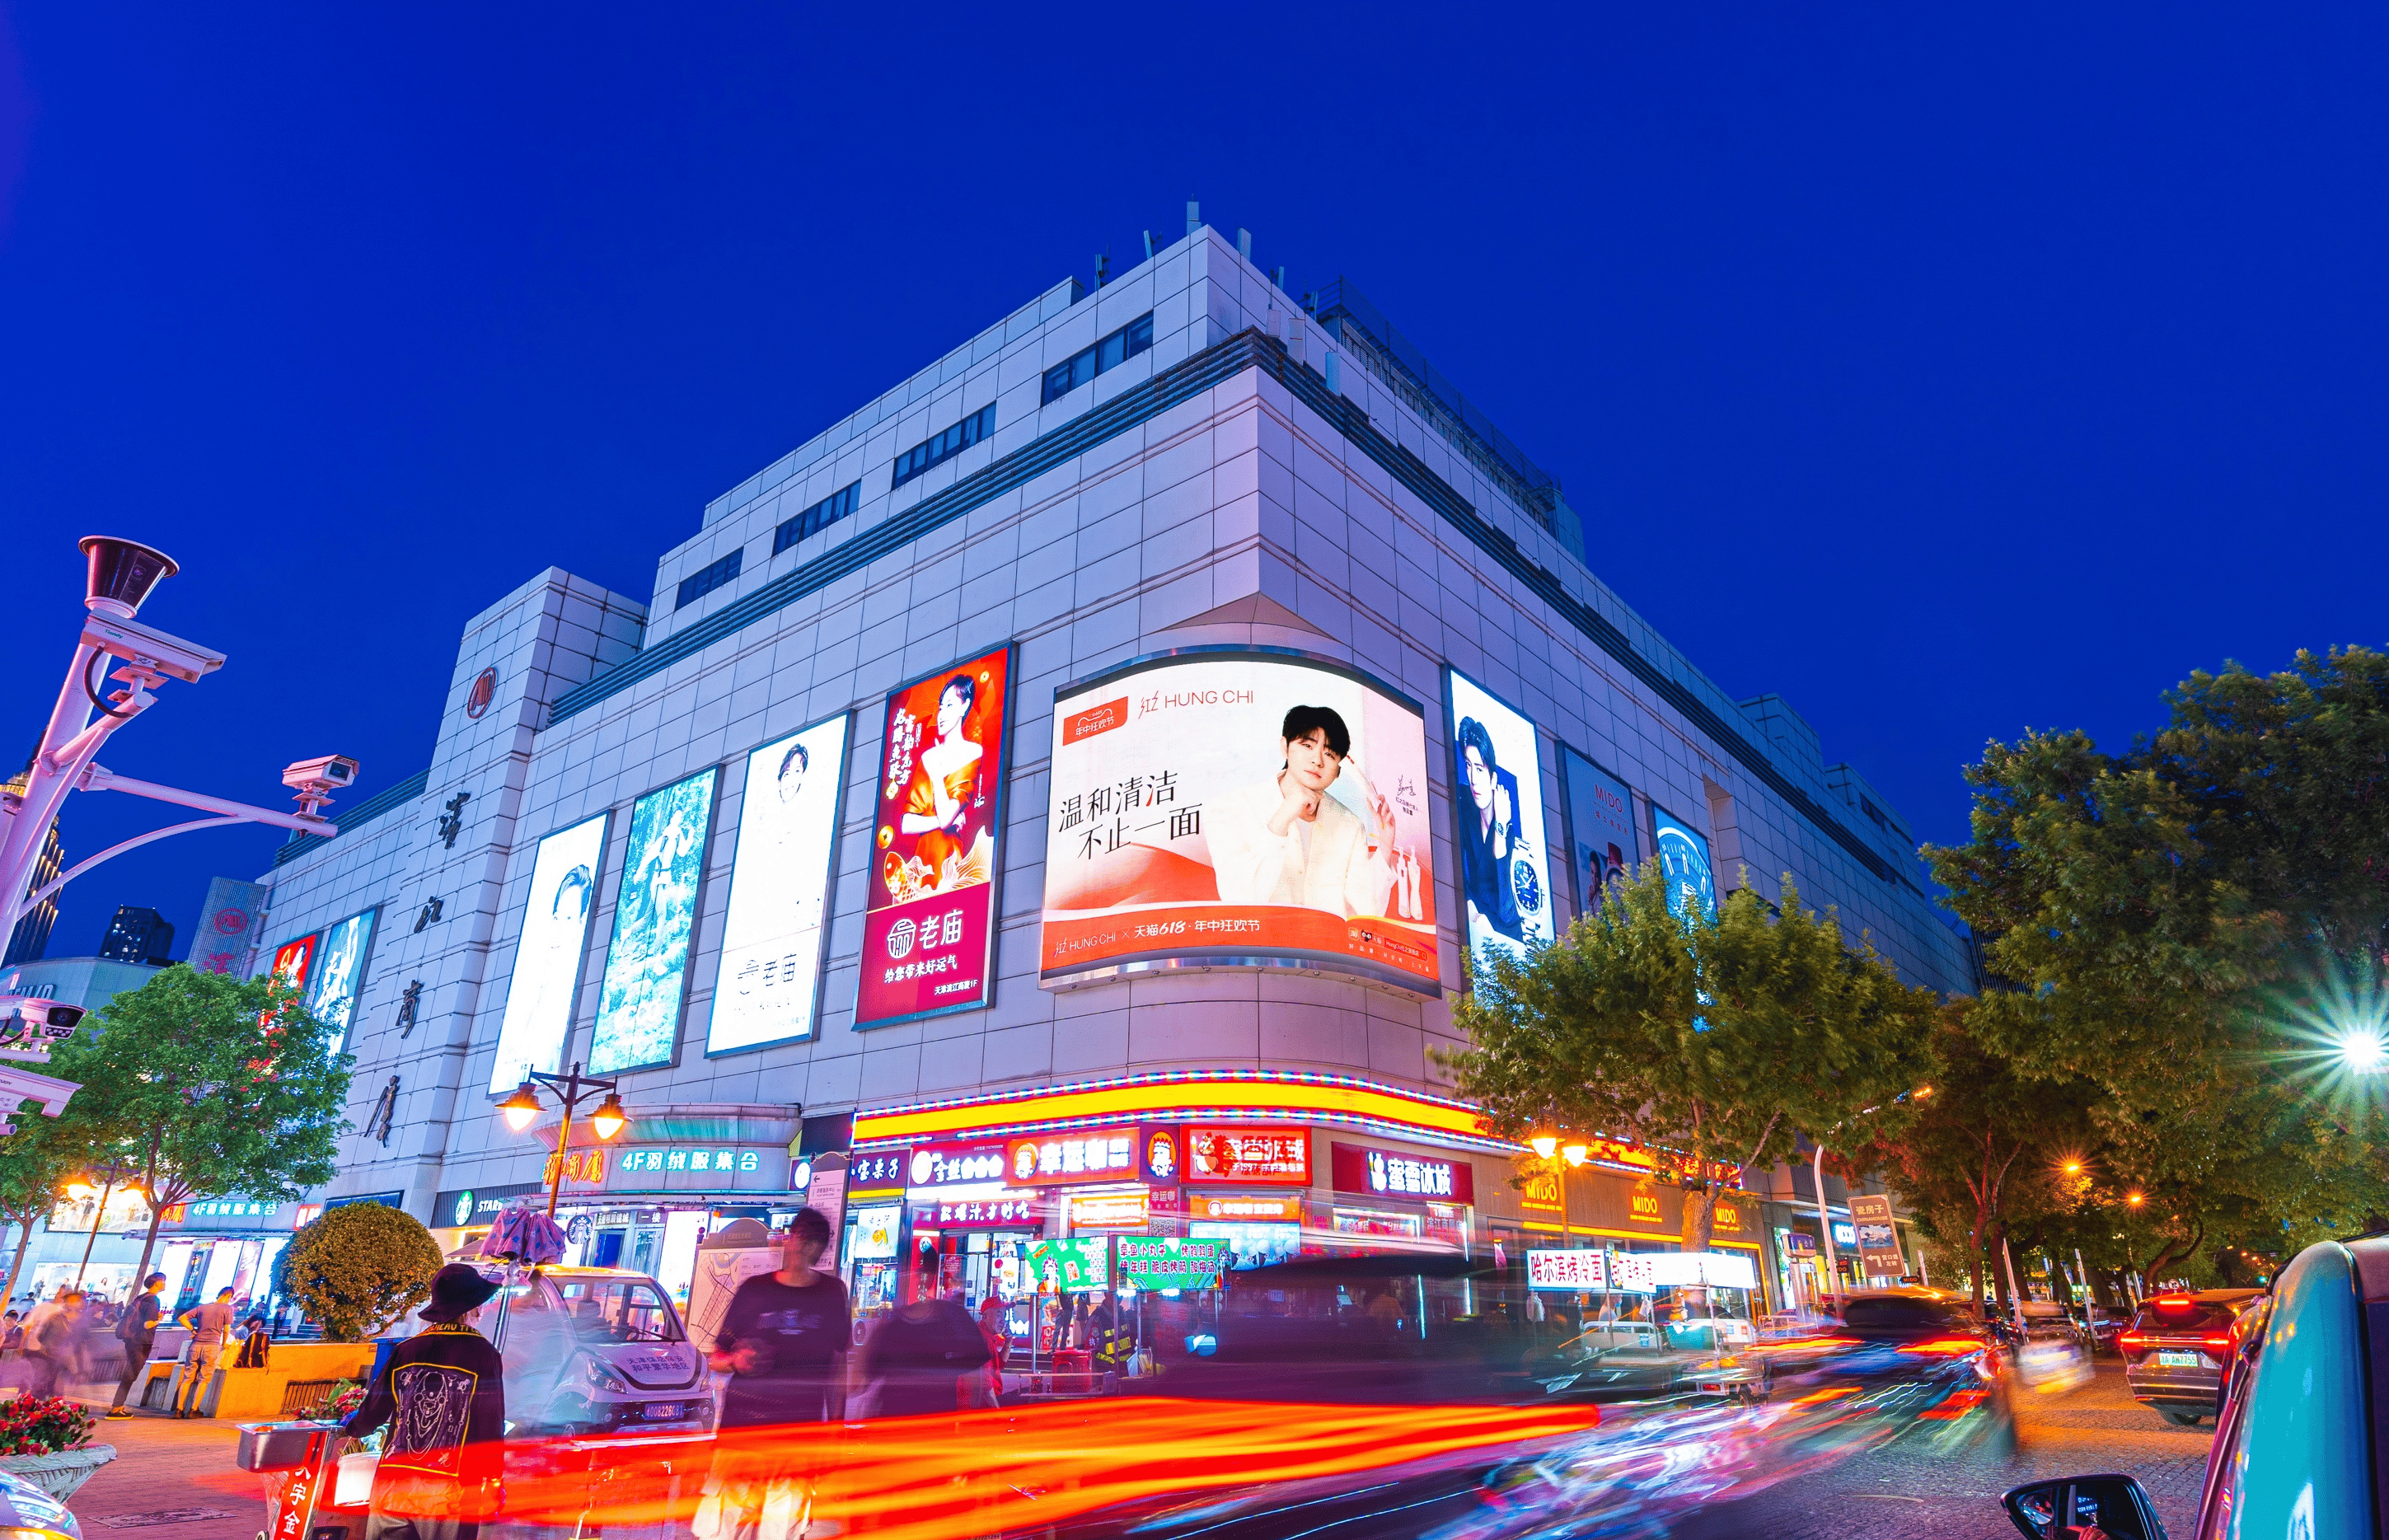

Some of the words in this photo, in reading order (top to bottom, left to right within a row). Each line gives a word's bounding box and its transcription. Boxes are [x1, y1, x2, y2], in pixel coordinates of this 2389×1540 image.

[1164, 690, 1218, 709] HUNG
[1222, 690, 1253, 704] CHI
[1075, 716, 1115, 737] 年中狂欢节
[1058, 770, 1178, 834] 温和清洁
[1595, 784, 1623, 813] MIDO
[1078, 802, 1203, 860] 不止一面
[919, 909, 963, 950] 老庙
[1069, 935, 1098, 951] HUNG
[1098, 932, 1116, 944] CHI
[621, 1150, 760, 1172] 4F羽绒服集合
[851, 1158, 899, 1182] 宝栗子
[1387, 1158, 1452, 1196] 蜜雪冰城
[1526, 1182, 1558, 1201] MIDO
[1632, 1196, 1658, 1214] MIDO
[1715, 1207, 1736, 1224] MIDO
[1855, 1204, 1885, 1215] 瓷房子
[1119, 1243, 1167, 1257] 章鱼小丸子
[1530, 1253, 1603, 1283] 哈尔滨烤冷面
